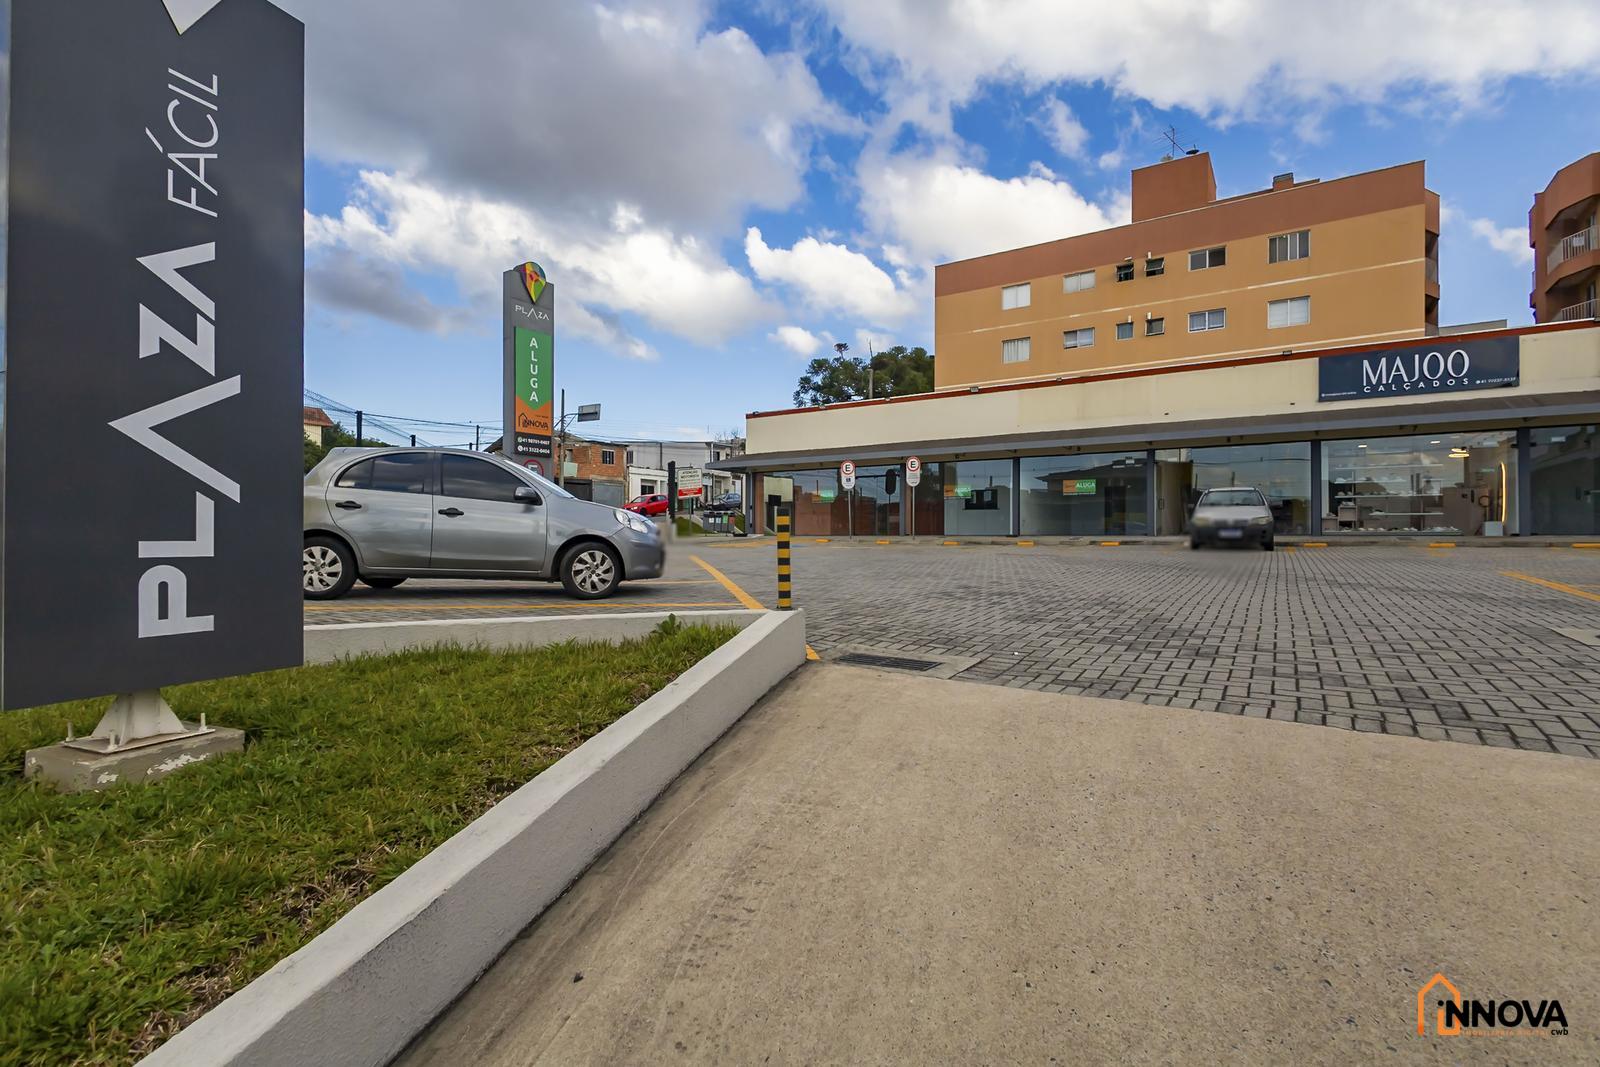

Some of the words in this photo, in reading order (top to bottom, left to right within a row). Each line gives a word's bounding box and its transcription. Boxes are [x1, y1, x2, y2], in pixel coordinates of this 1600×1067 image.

[145, 67, 219, 218] FÁCIL
[515, 304, 549, 321] PLAZA
[529, 337, 539, 402] ALUGA
[1362, 349, 1470, 387] MAJOO
[1363, 377, 1469, 393] CALÇADOS
[106, 241, 242, 639] PLAZA
[845, 464, 852, 472] E
[910, 460, 917, 468] E
